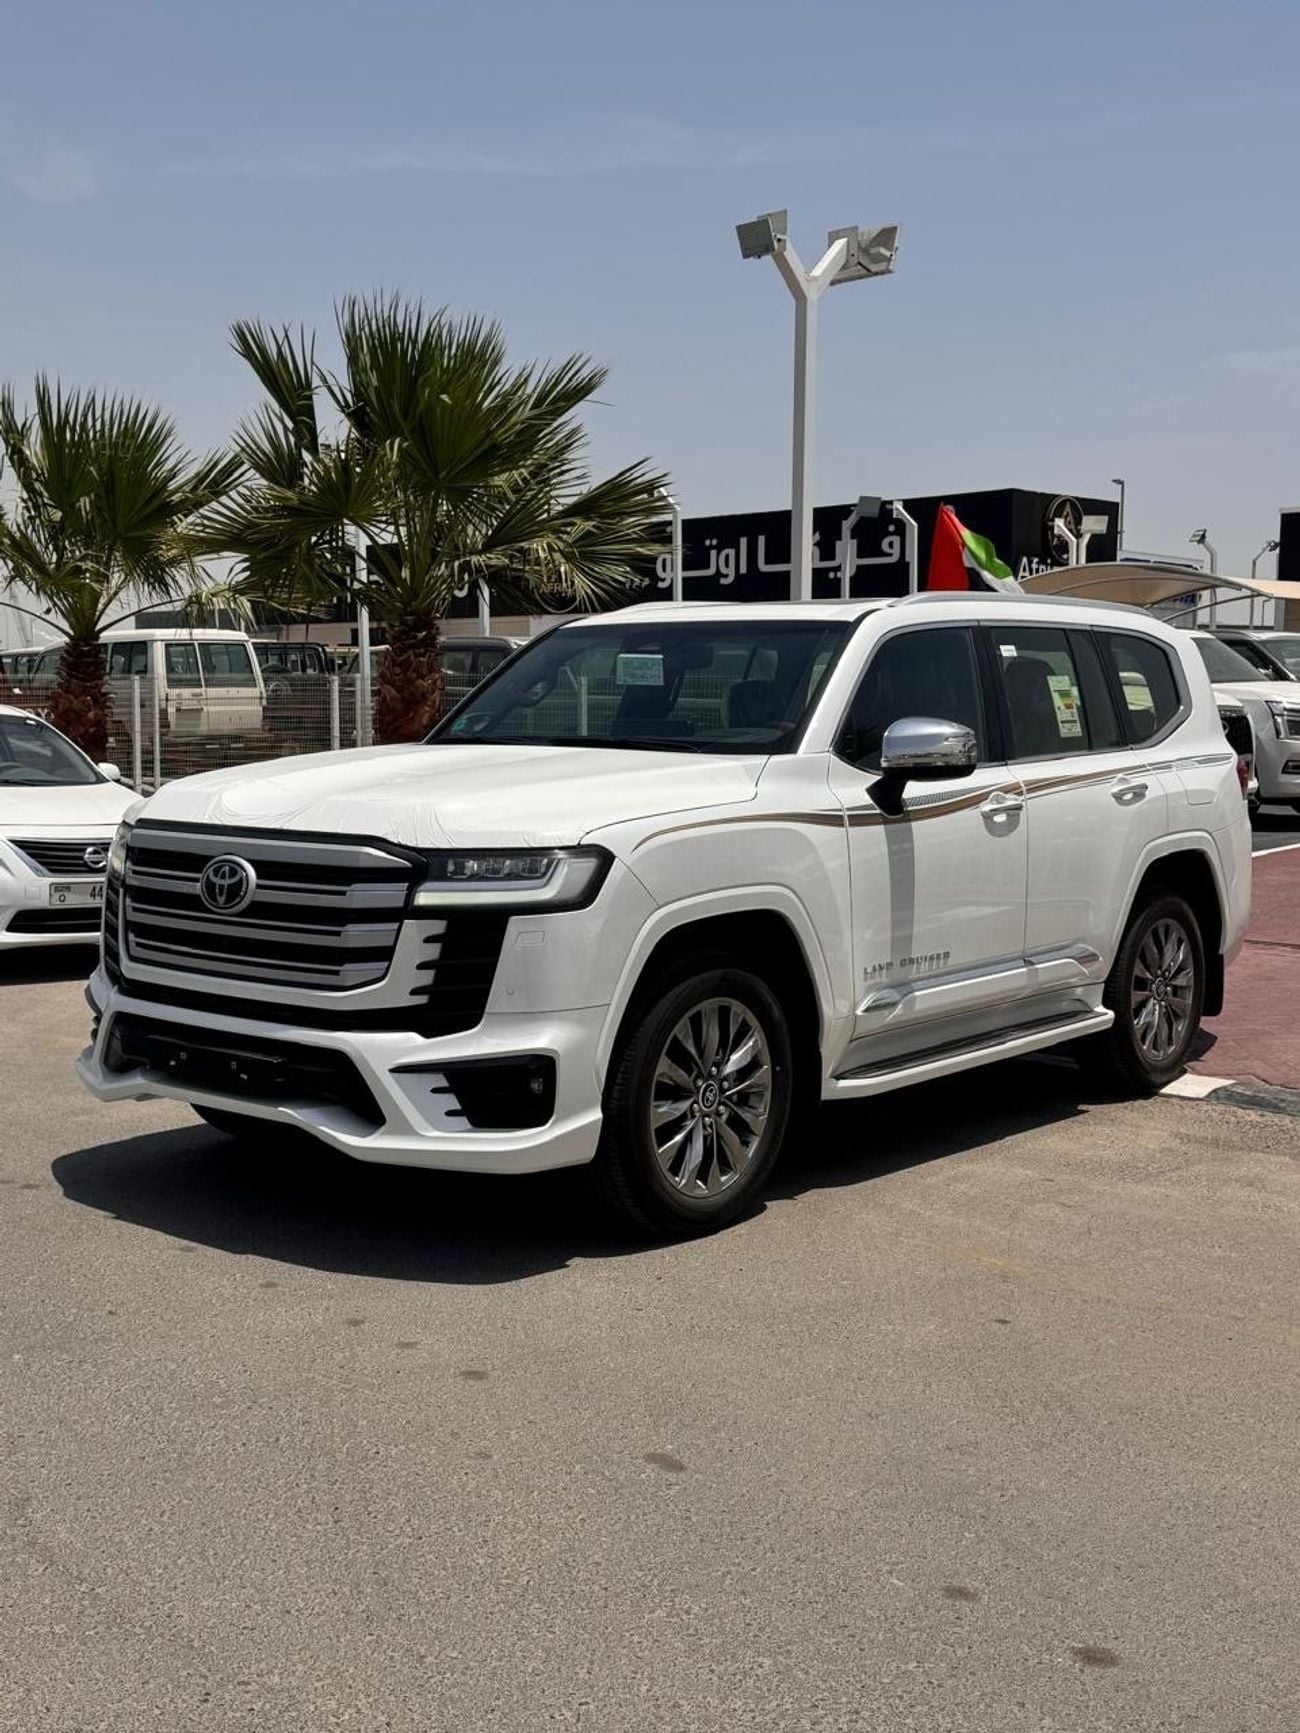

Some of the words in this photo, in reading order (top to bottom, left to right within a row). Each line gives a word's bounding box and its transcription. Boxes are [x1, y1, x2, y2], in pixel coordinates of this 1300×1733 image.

[1018, 556, 1052, 581] Afri
[863, 960, 894, 975] LAND
[899, 950, 951, 968] CRUISER
